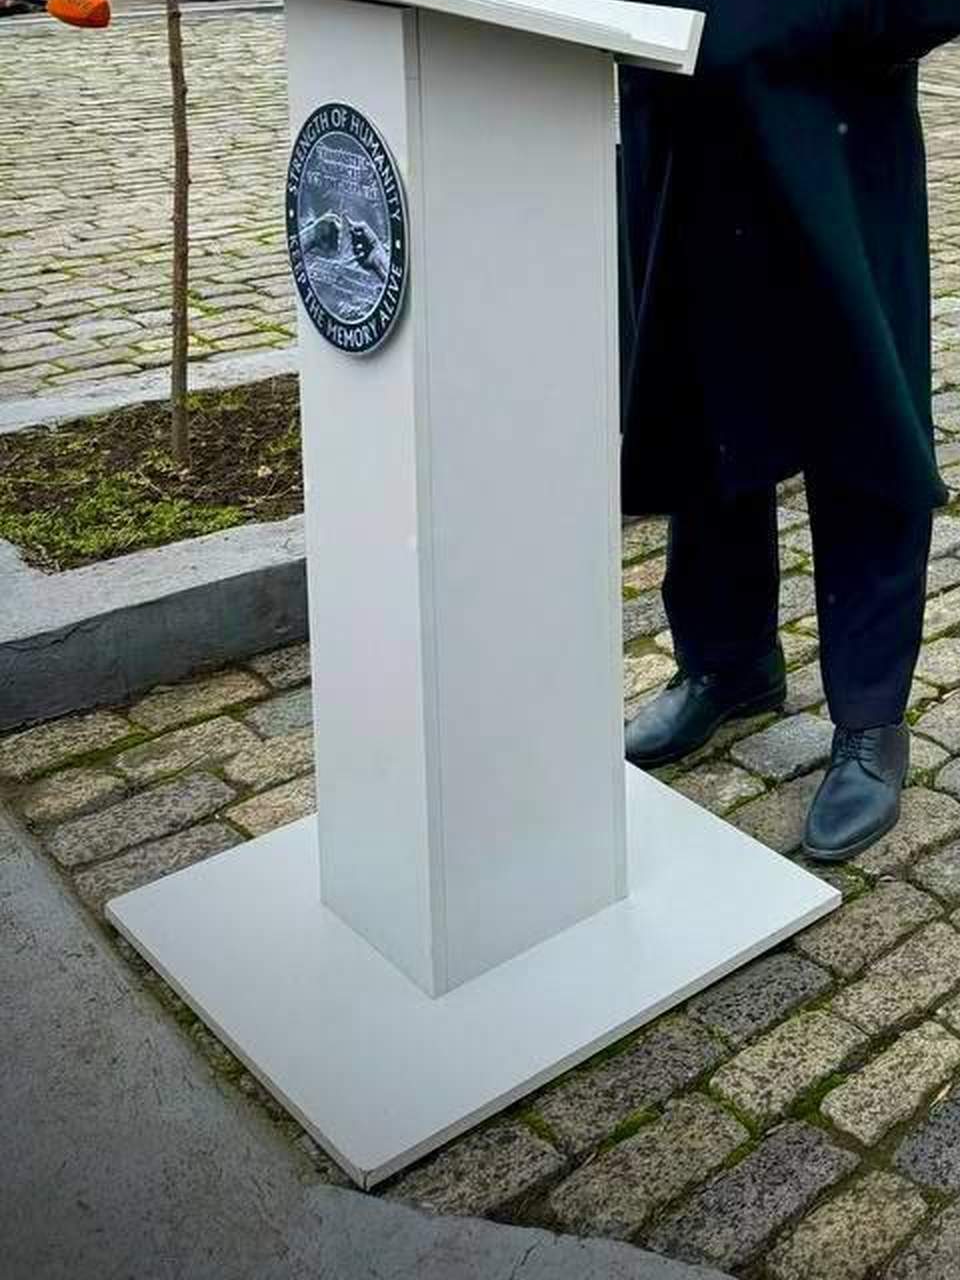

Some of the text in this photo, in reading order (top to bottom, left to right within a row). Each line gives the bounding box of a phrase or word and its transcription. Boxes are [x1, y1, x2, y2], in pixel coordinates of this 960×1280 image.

[288, 108, 401, 221] STRENGTH OF HUMANITY
[305, 287, 323, 328] THE
[327, 319, 378, 348] MEMORY
[379, 263, 403, 328] ALIVE
